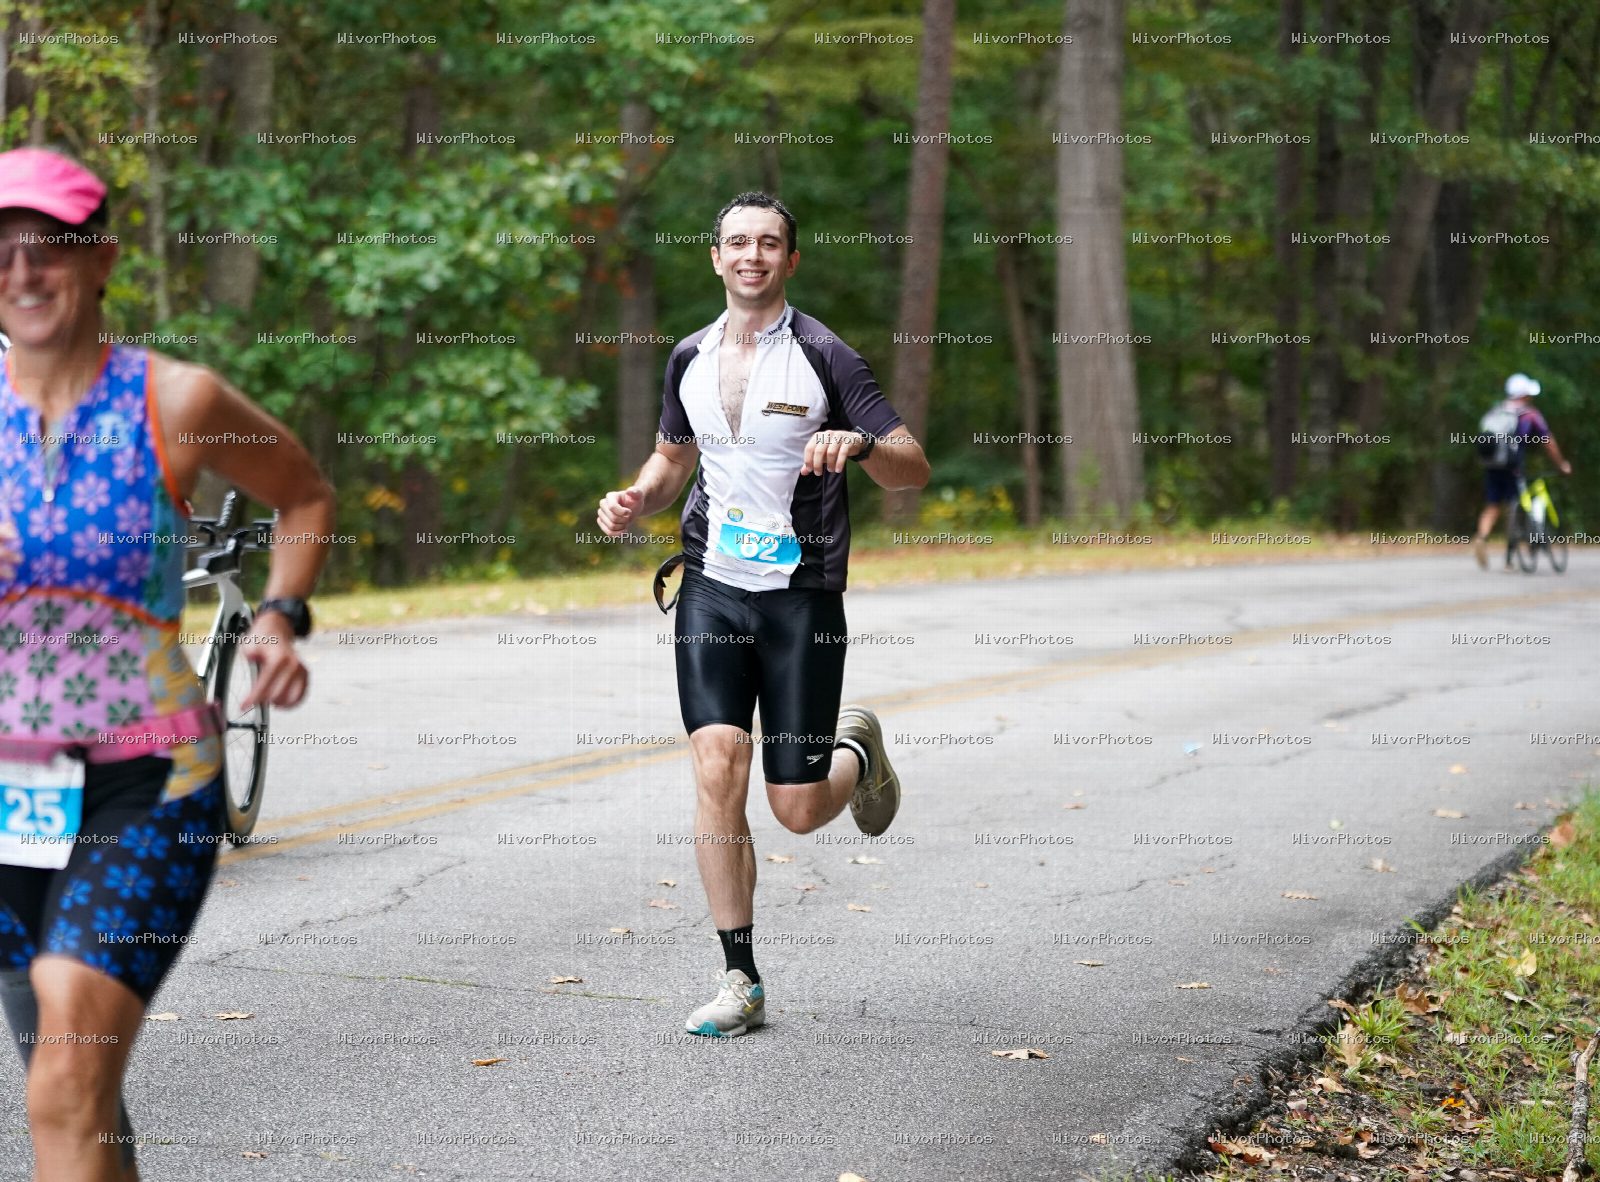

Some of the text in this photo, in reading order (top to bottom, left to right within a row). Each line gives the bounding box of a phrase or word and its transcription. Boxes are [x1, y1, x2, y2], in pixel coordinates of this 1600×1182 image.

[766, 401, 810, 414] WEST POINT
[740, 532, 779, 562] 62
[4, 787, 67, 835] 25
